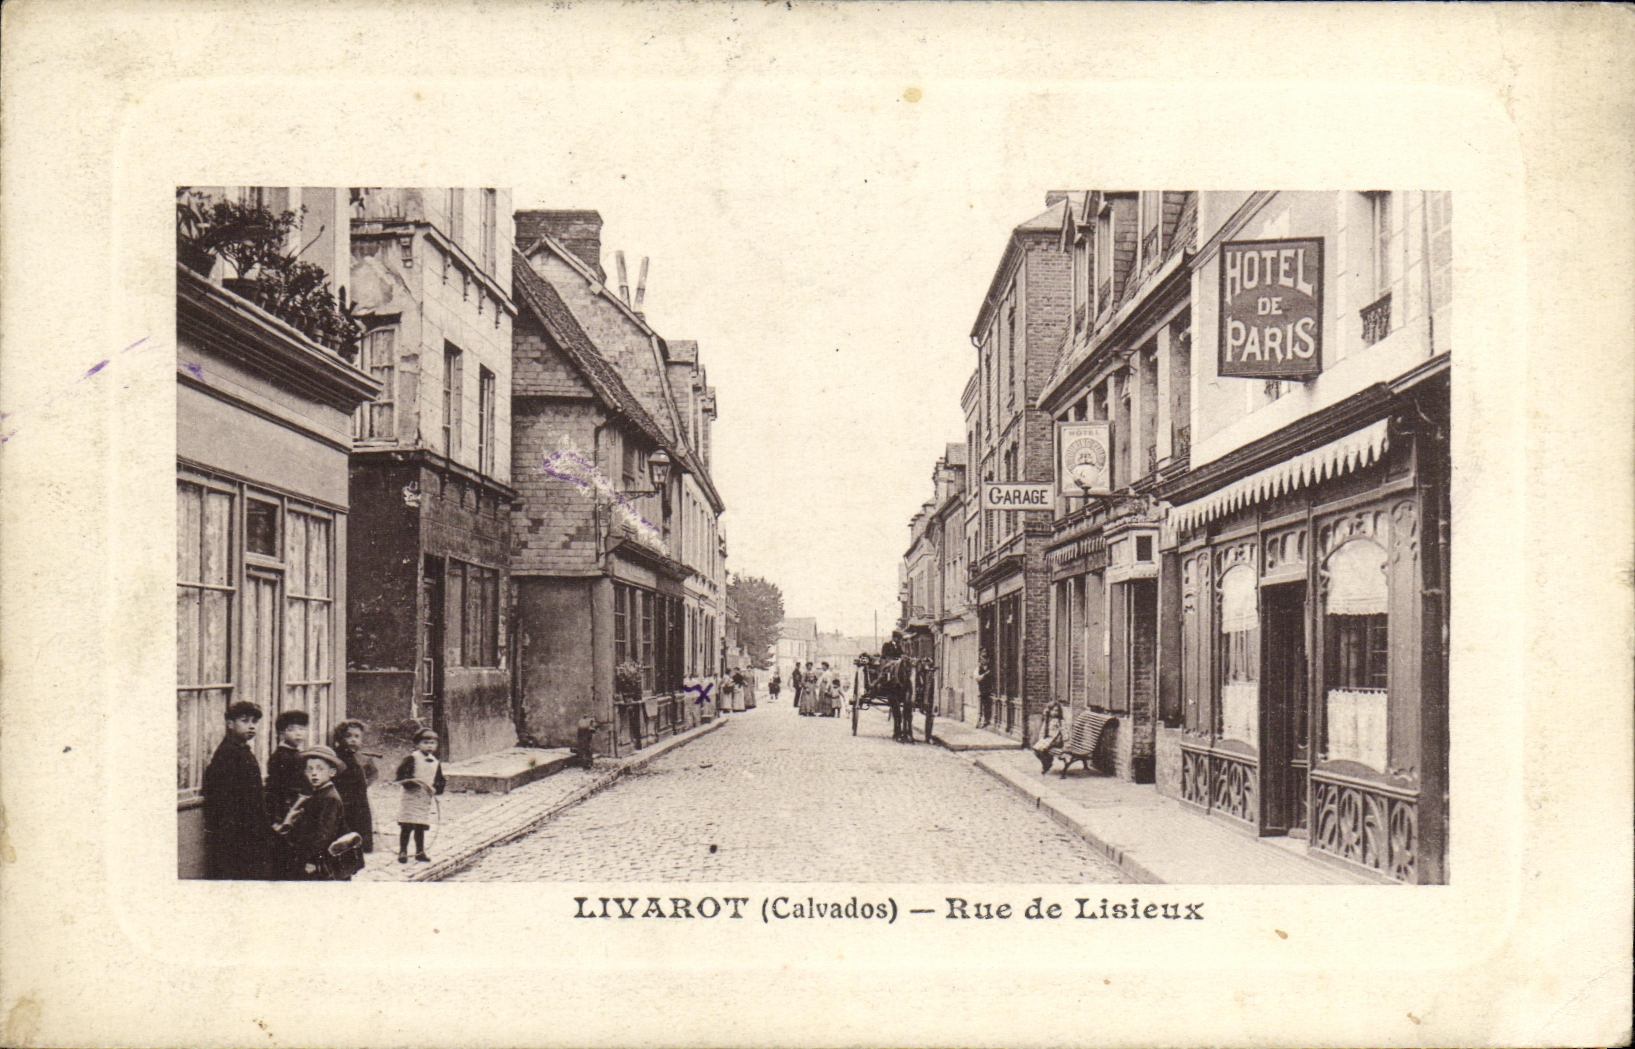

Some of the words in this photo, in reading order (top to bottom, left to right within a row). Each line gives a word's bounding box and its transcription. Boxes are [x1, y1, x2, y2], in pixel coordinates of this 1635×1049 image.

[1225, 248, 1314, 305] HOTEL
[1257, 296, 1283, 316] DE
[1225, 316, 1316, 364] PARIS
[988, 486, 1049, 505] GARAGE
